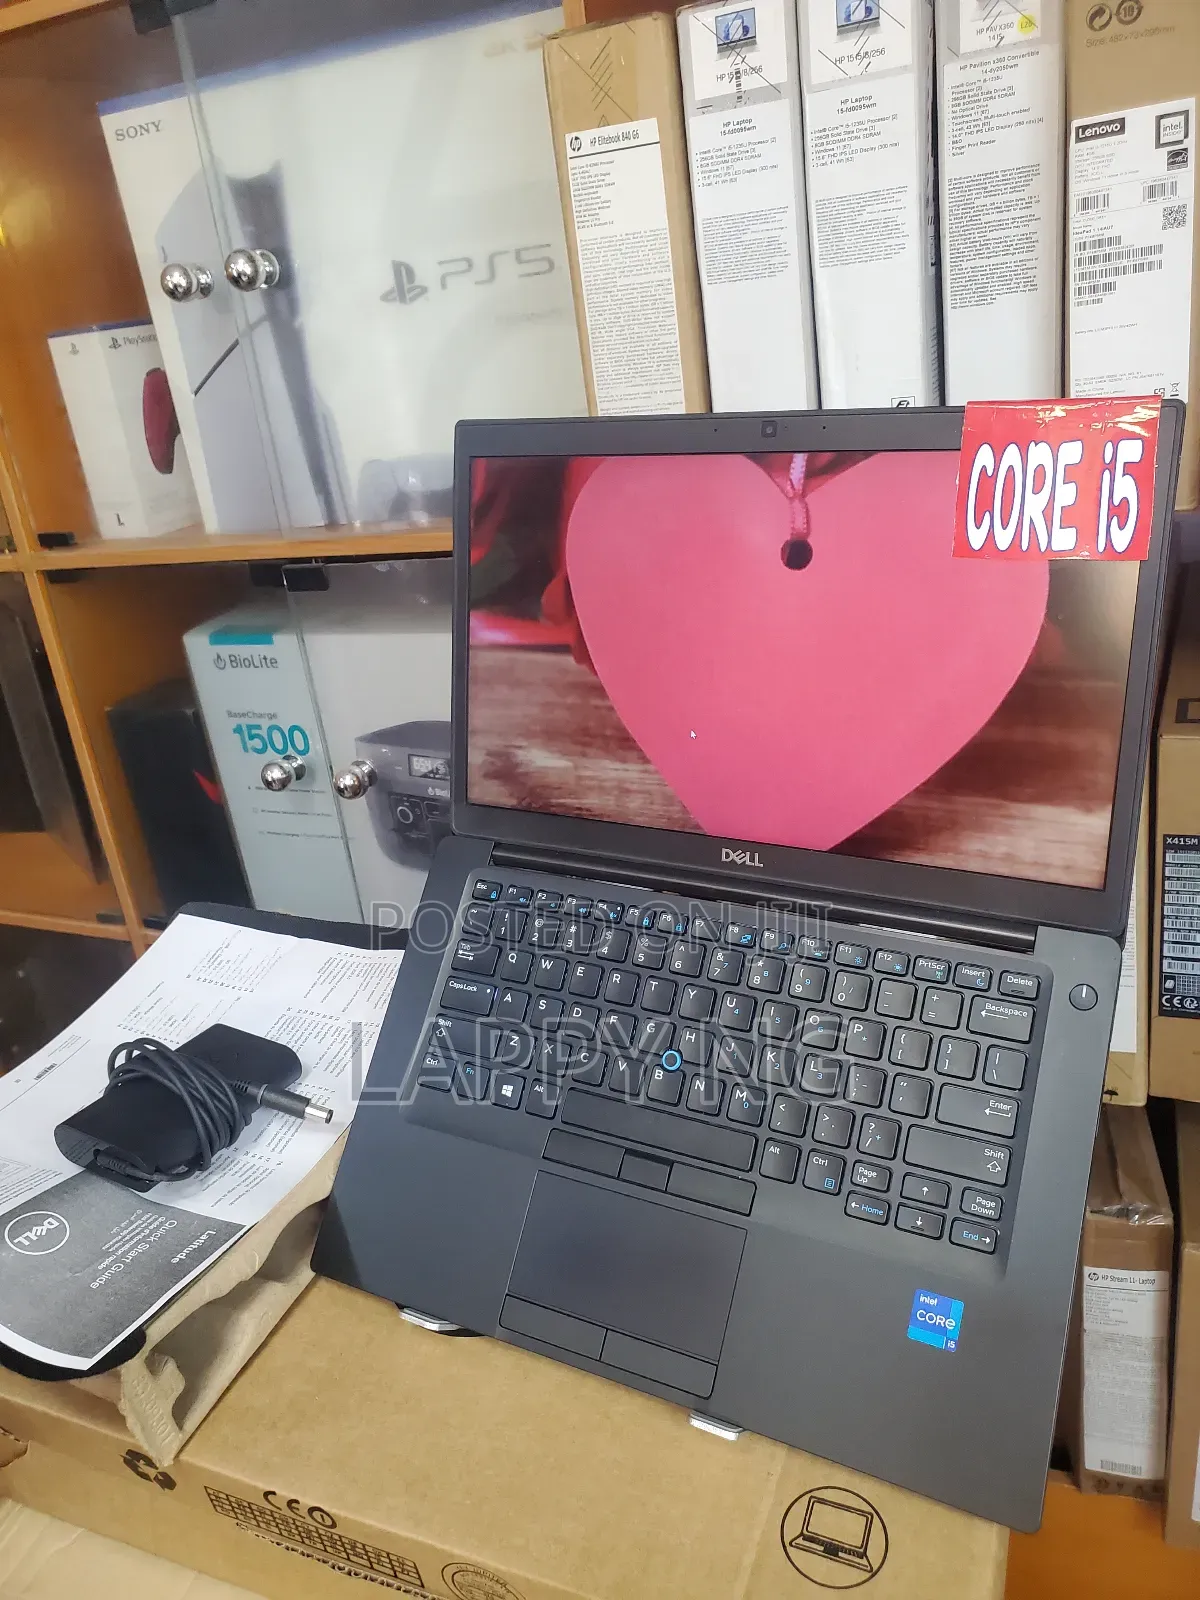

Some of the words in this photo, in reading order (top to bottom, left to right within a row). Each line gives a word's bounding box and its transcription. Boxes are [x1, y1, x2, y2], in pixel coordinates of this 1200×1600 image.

[1122, 5, 1134, 18] 10
[976, 28, 984, 36] HP
[985, 26, 998, 34] PAV
[834, 56, 845, 65] HP
[847, 54, 854, 63] 15
[969, 60, 991, 70] Pavilion
[1007, 50, 1040, 62] Convertible
[716, 74, 726, 82] HP
[840, 98, 850, 106] HP
[851, 94, 872, 104] Laptop
[733, 118, 753, 127] Laptop
[867, 116, 891, 124] Processor
[114, 119, 162, 142] SONY
[863, 131, 881, 140] SDRAM
[1079, 123, 1120, 138] Lenovo
[590, 136, 597, 148] HP
[598, 132, 621, 146] Elitebook
[438, 244, 556, 290] PS5
[966, 439, 1084, 553] CORE
[1097, 438, 1144, 554] i5
[229, 654, 278, 669] BioLite
[226, 710, 278, 720] BaseCharge
[232, 723, 310, 756] 1500
[721, 848, 763, 867] DELL
[477, 882, 488, 890] Esc
[629, 908, 638, 916] F5
[460, 942, 470, 950] Tab
[508, 953, 517, 964] Q
[541, 959, 553, 970] W
[919, 960, 945, 970] PrtScr
[577, 967, 585, 977] E
[962, 967, 985, 978] Insert
[612, 974, 621, 984] R
[1007, 976, 1033, 986] Delete
[449, 981, 463, 990] Caps
[464, 983, 478, 992] Lock
[650, 981, 658, 991] T
[504, 993, 512, 1002] A
[688, 988, 697, 999] Y
[539, 1000, 547, 1009] S
[726, 997, 736, 1008] U
[573, 1008, 582, 1017] D
[985, 1002, 1028, 1018] Backspace
[438, 1018, 452, 1028] Shift
[610, 1015, 618, 1024] F
[810, 1015, 820, 1025] O
[646, 1022, 656, 1033] G
[854, 1024, 864, 1033] P
[510, 1036, 519, 1046] Z
[685, 1032, 696, 1042] H
[544, 1044, 554, 1054] X
[726, 1043, 734, 1052] J
[426, 1057, 438, 1066] Ctrl
[580, 1053, 590, 1062] C
[767, 1051, 776, 1062] K
[466, 1067, 475, 1076] Fn
[618, 1061, 627, 1071] V
[810, 1061, 818, 1072] L
[655, 1070, 663, 1080] B
[534, 1085, 544, 1093] Alt
[695, 1080, 705, 1091] N
[735, 1090, 746, 1101] M
[989, 1100, 1012, 1111] Enter
[769, 1146, 780, 1155] Alt
[984, 1149, 1005, 1160] Shift
[813, 1157, 828, 1166] Ctrl
[859, 1167, 877, 1178] Page
[857, 1175, 868, 1184] Up
[976, 1196, 996, 1207] Page
[861, 1204, 884, 1216] Home
[971, 1204, 995, 1216] Down
[149, 1217, 166, 1230] Guide
[14, 1218, 60, 1246] DELL
[146, 1220, 177, 1242] Quick
[963, 1230, 979, 1241] End
[121, 1242, 150, 1262] Start
[171, 1230, 216, 1264] Latitude
[90, 1263, 124, 1289] Guide
[920, 1294, 938, 1306] intel
[948, 1340, 955, 1348] i5
